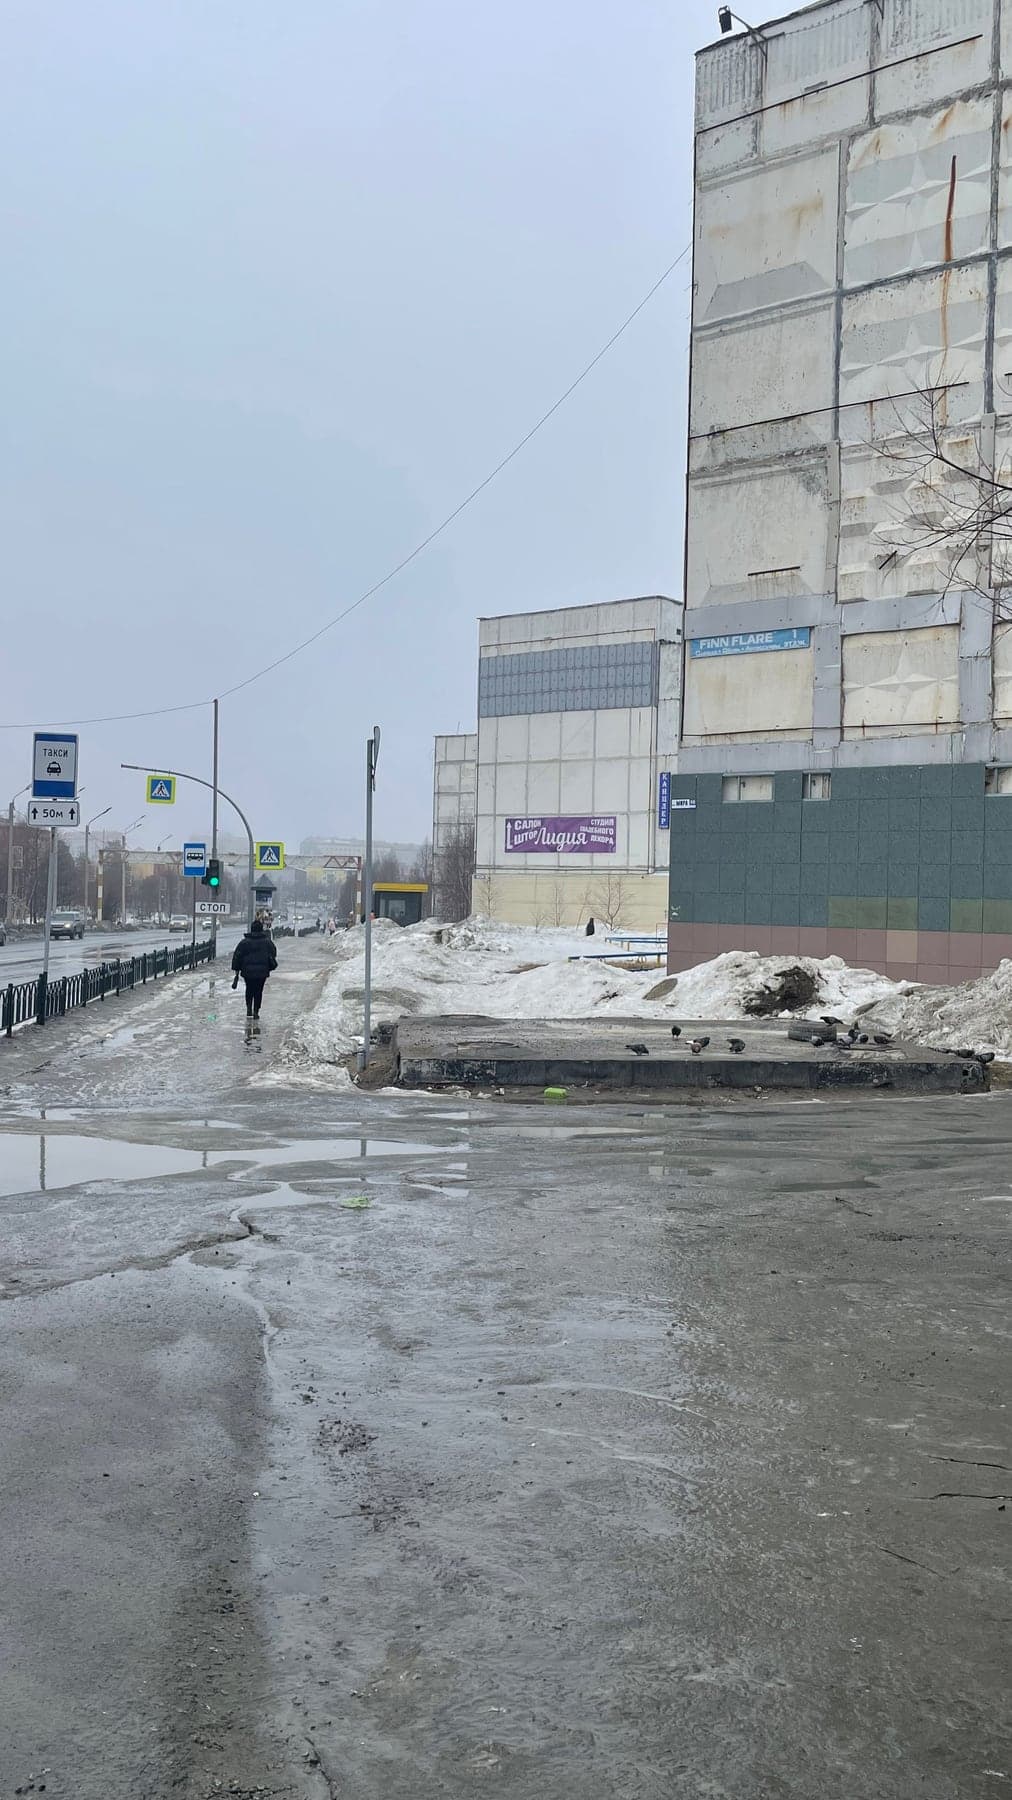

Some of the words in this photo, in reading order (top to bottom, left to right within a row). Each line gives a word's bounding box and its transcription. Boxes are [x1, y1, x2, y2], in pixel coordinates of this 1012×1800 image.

[731, 632, 773, 647] FLARE
[791, 629, 797, 639] 1
[514, 820, 541, 831] САЛОН
[514, 830, 538, 845] ШТОР
[534, 827, 588, 851] Лидия
[200, 903, 226, 912] СТОП
